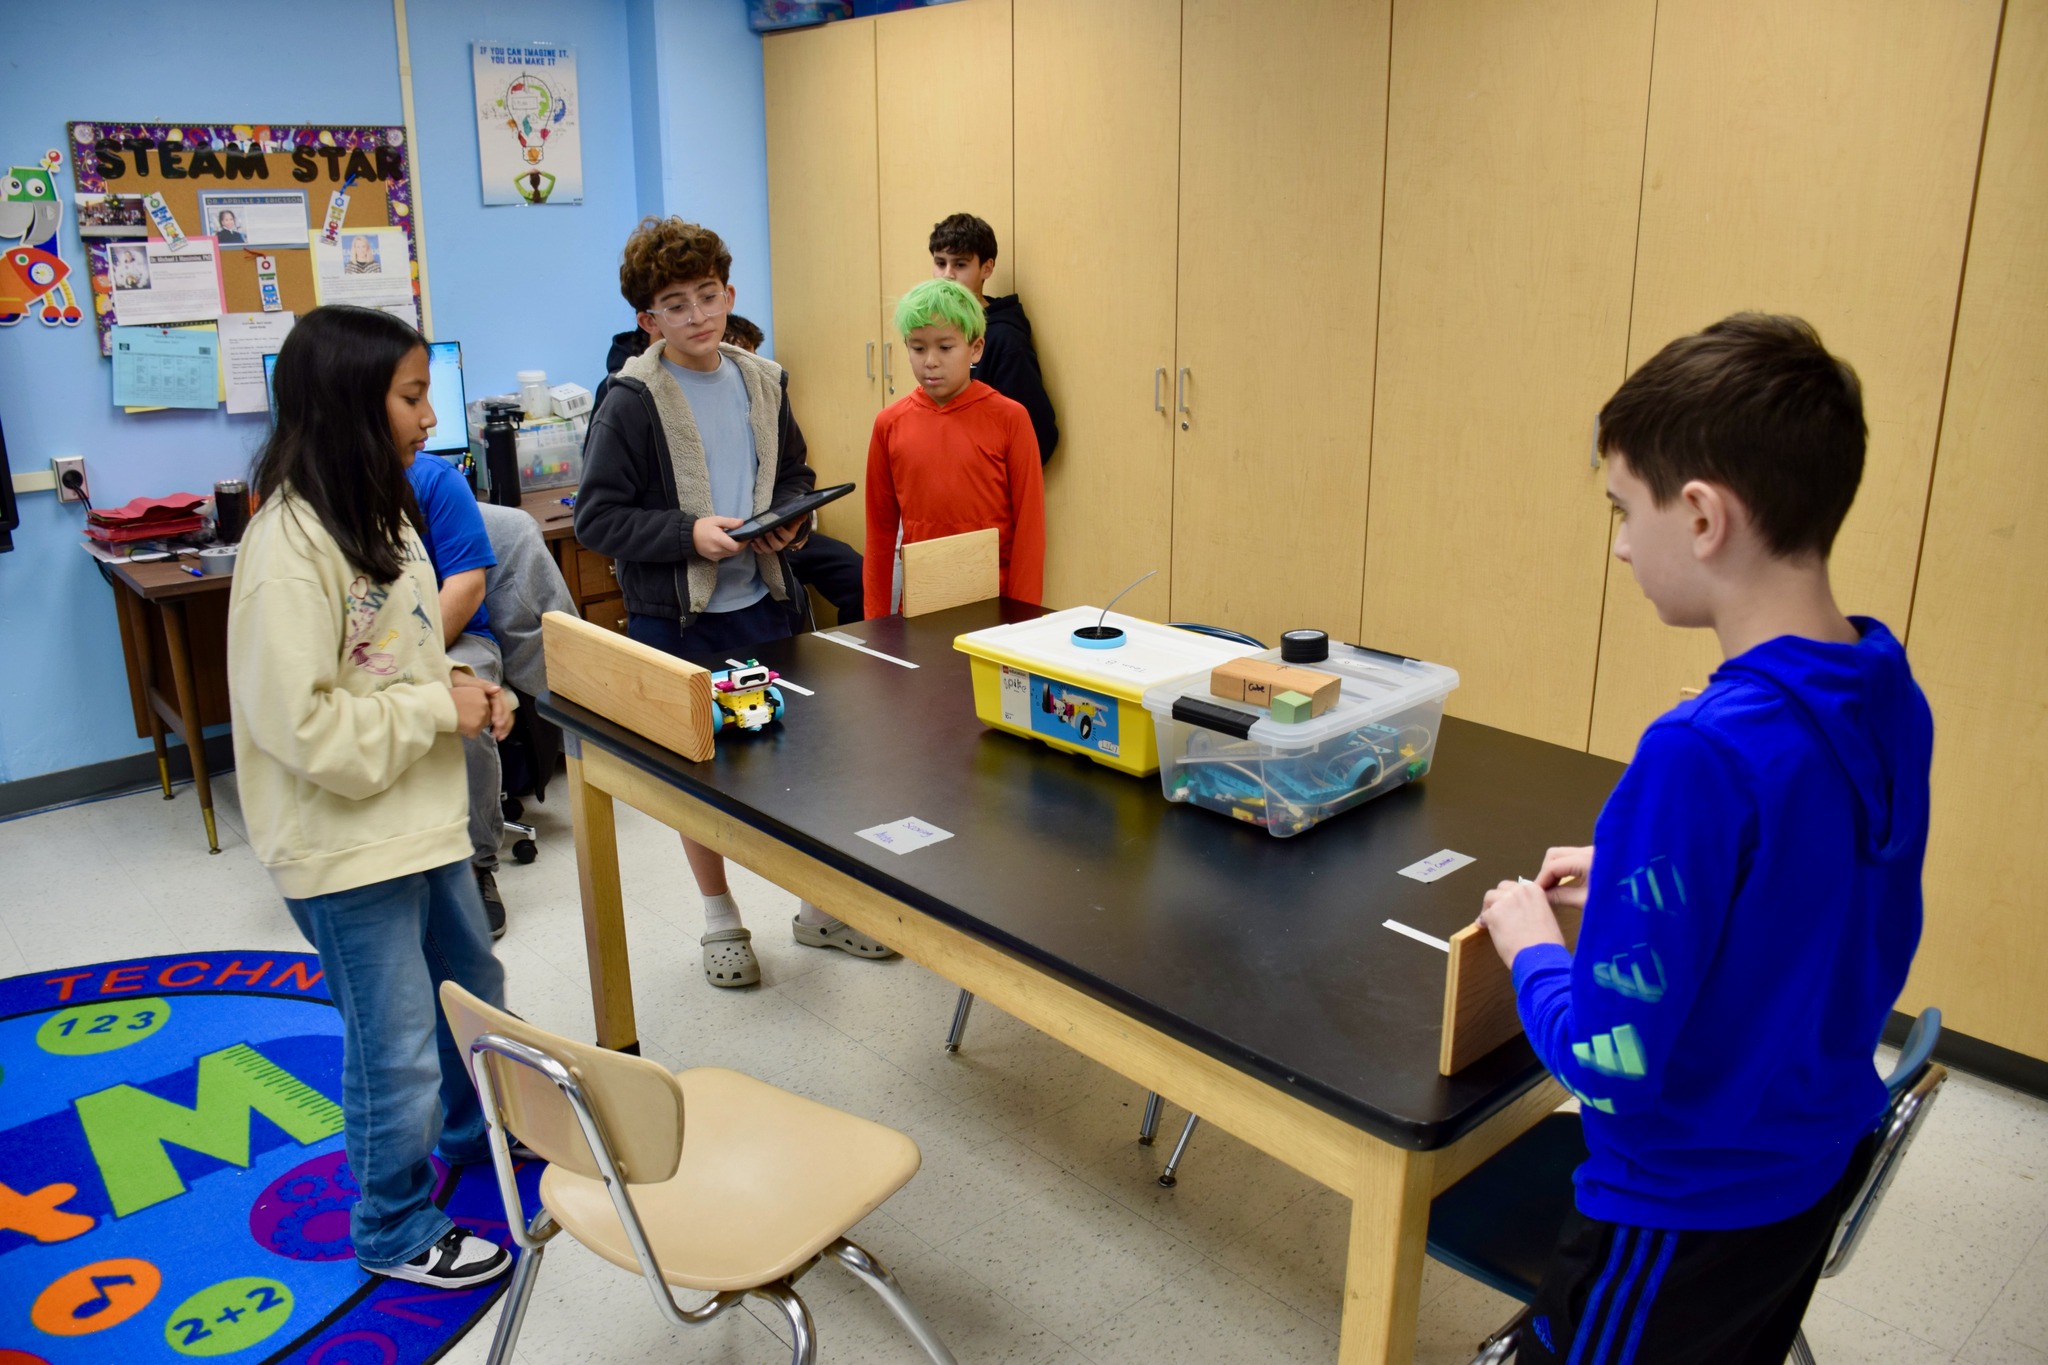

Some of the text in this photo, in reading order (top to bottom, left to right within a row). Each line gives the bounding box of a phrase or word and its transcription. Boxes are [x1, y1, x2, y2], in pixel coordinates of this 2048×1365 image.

[480, 46, 488, 55] IF
[490, 47, 505, 55] YOU
[507, 48, 522, 56] CAN
[524, 48, 556, 57] IMAGINE
[491, 56, 556, 66] YOU CAN MAKE IT
[95, 138, 403, 183] STEAM STAR
[1248, 683, 1265, 693] Cube
